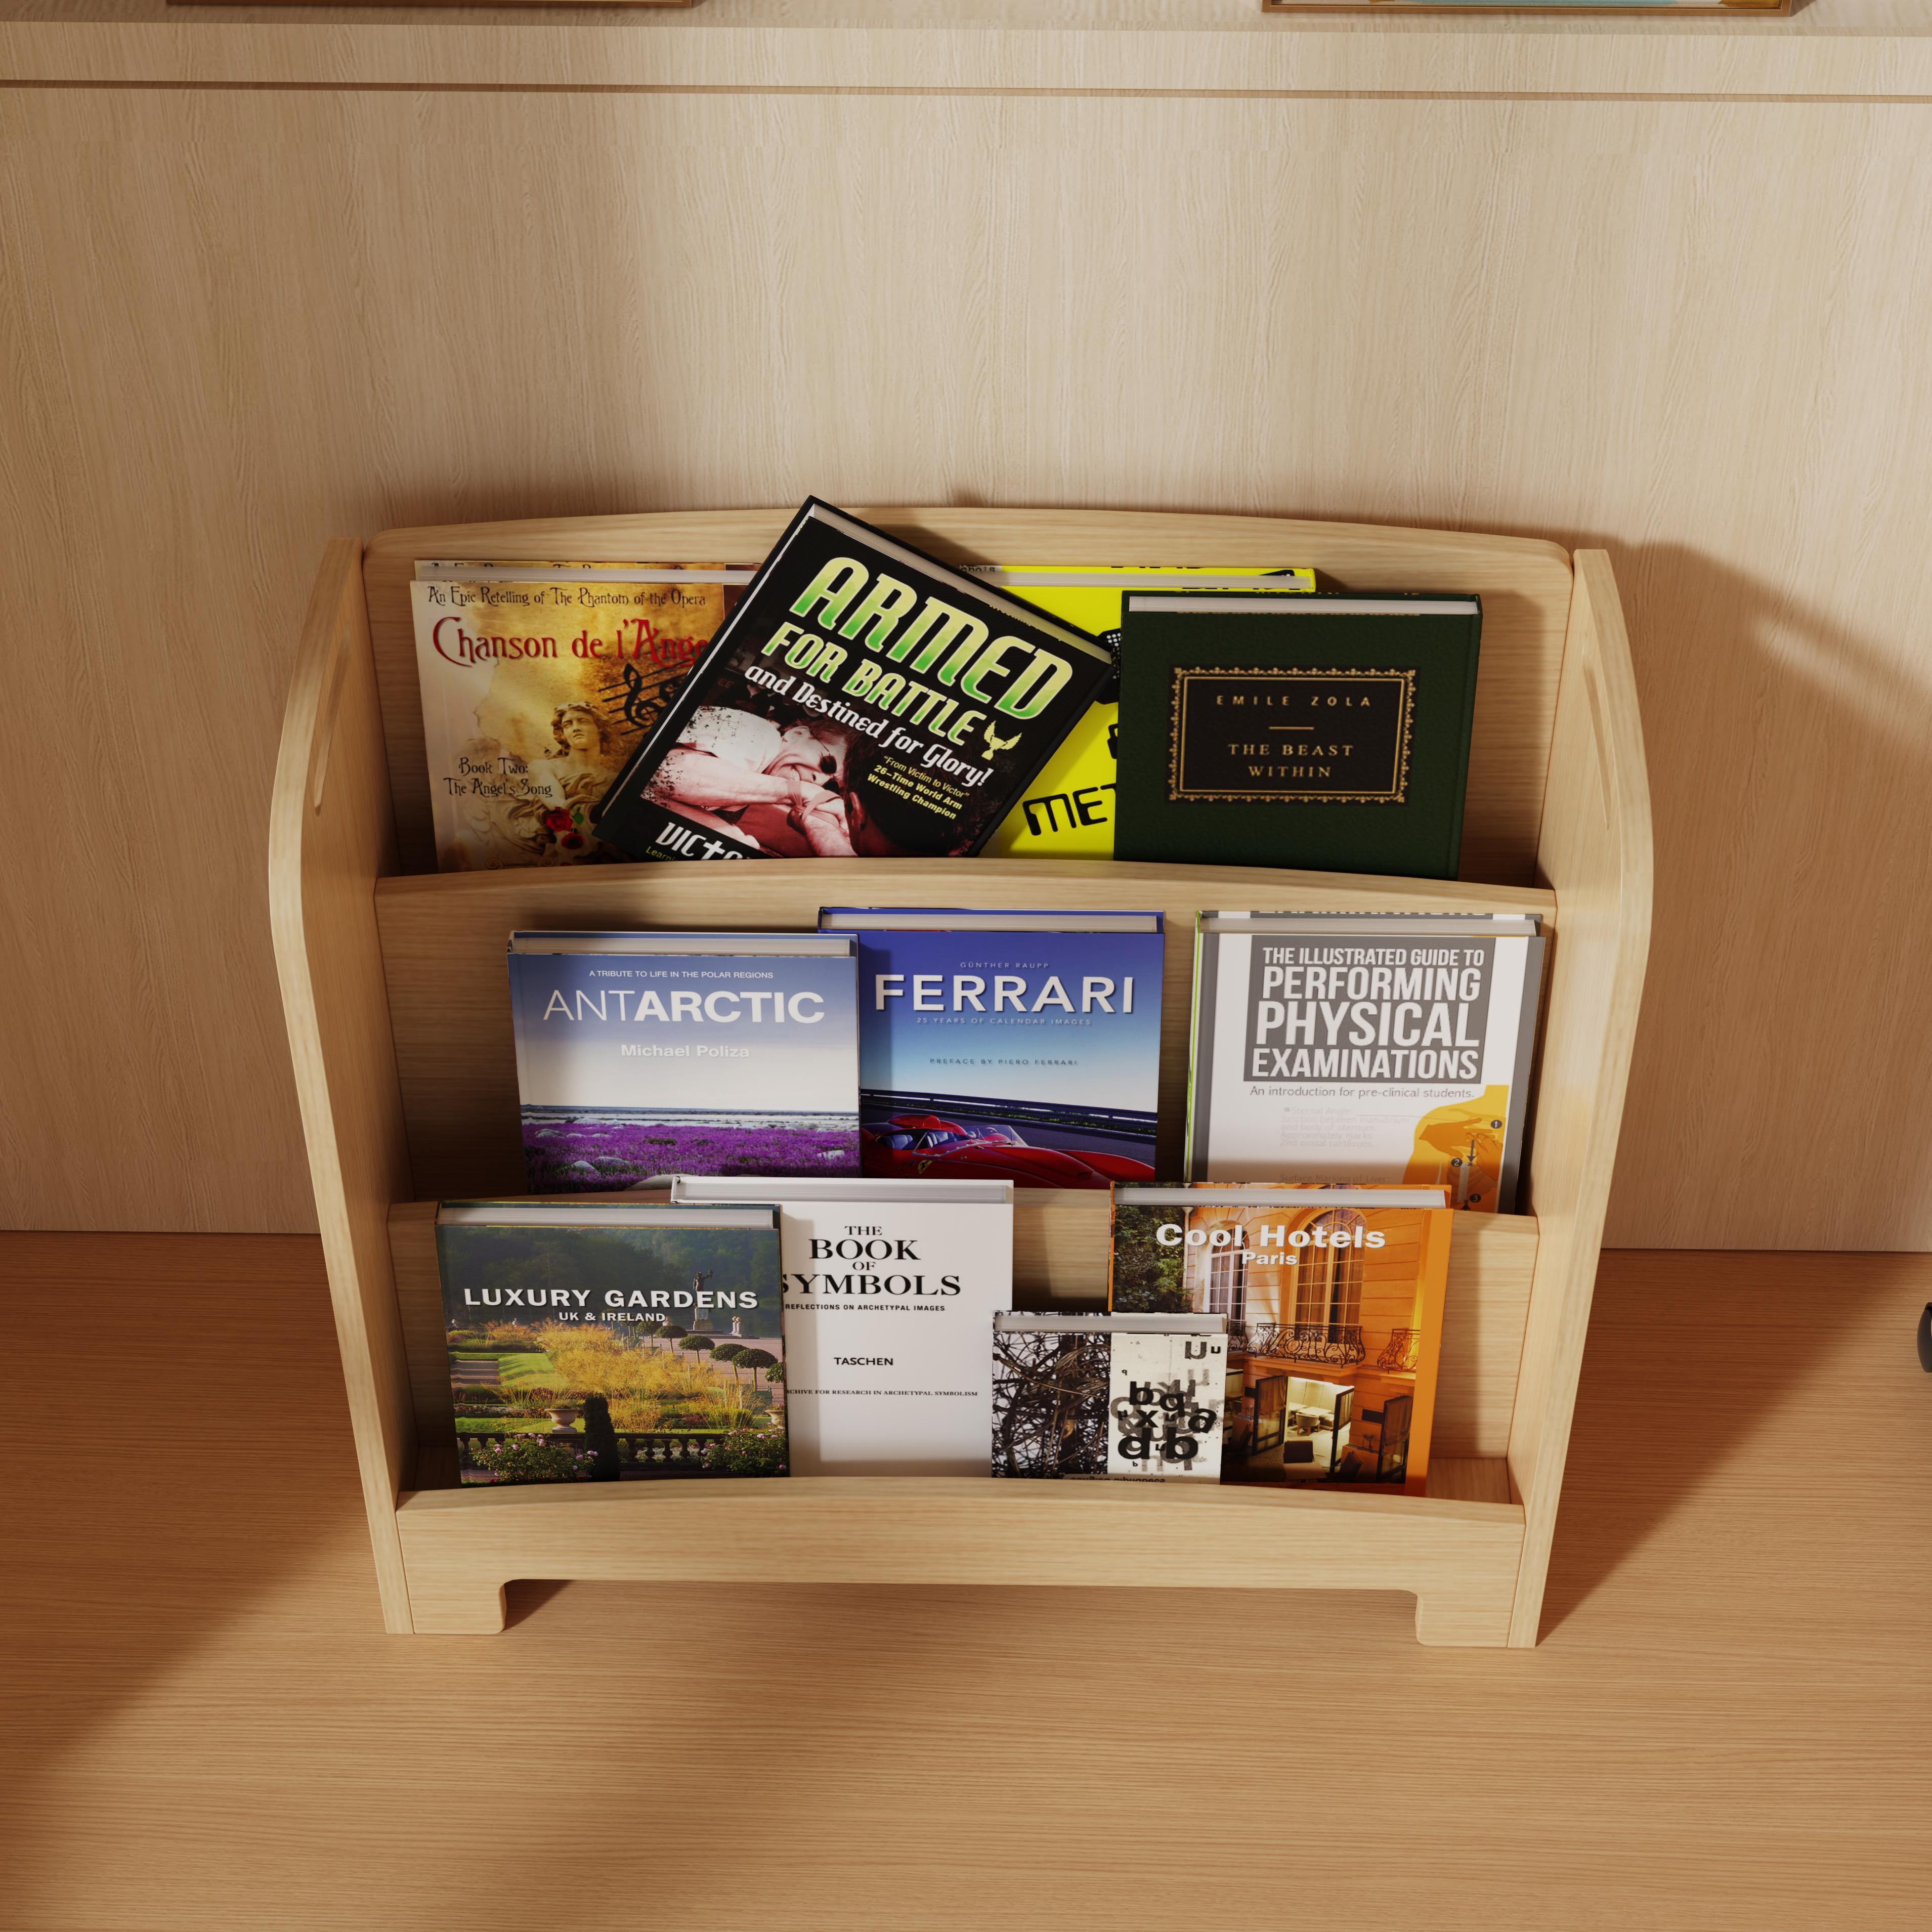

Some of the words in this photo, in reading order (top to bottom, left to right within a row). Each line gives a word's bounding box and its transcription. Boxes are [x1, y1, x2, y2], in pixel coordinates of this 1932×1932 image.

[427, 586, 446, 606] An
[451, 586, 476, 607] Epic
[480, 586, 530, 607] Retelling
[534, 591, 545, 605] of
[550, 587, 572, 606] The
[578, 587, 629, 607] Phantom
[634, 592, 645, 605] of
[650, 592, 666, 607] the
[671, 588, 706, 608] Opera
[433, 616, 557, 667] Chanson
[572, 629, 603, 658] de
[789, 557, 1073, 719] ARMED
[761, 621, 848, 684] FOR
[841, 659, 988, 746] BATTLE
[1216, 695, 1290, 706] EMILE
[1311, 696, 1370, 707] ZOLA
[744, 665, 796, 697] and
[792, 682, 887, 739] Destined
[878, 726, 924, 754] for
[920, 743, 994, 787] Glory!
[1228, 744, 1270, 756] THE
[1281, 744, 1353, 756] BEAST
[458, 757, 493, 776] Book
[497, 757, 529, 776] Two:
[908, 766, 932, 784] Victim
[932, 779, 941, 788] to
[1248, 765, 1332, 778] WITHIN
[443, 777, 467, 796] The
[471, 778, 516, 798] Angel's
[516, 778, 553, 798] Song
[867, 773, 911, 800] Wrestling
[912, 794, 957, 820] Champion
[916, 783, 943, 801] World
[942, 796, 963, 810] Arm
[1263, 947, 1295, 964] THE
[1299, 947, 1407, 965] ILLUSTRATED
[1410, 949, 1460, 966] GUIDE
[1463, 949, 1485, 966] TO
[875, 974, 1134, 1013] FERRARI
[1262, 966, 1481, 1002] PERFORMING
[543, 990, 825, 1023] ANTARCTIC
[1256, 1000, 1480, 1047] PHYSICAL
[620, 1044, 690, 1058] Michael
[697, 1045, 750, 1058] Poliza
[1252, 1047, 1479, 1080] EXAMINATIONS
[1250, 1086, 1265, 1096] An
[1268, 1086, 1336, 1097] introduction
[1339, 1086, 1355, 1097] for
[1358, 1087, 1419, 1099] pre-clinical
[1423, 1087, 1475, 1098] students.
[1280, 1174, 1313, 1182] Surface
[845, 1225, 882, 1236] THE
[1155, 1223, 1243, 1247] Cool
[1260, 1224, 1387, 1249] Hotels
[808, 1238, 921, 1260] BOOK
[1242, 1251, 1298, 1265] Paris
[852, 1261, 876, 1271] OF
[463, 1288, 591, 1306] LUXURY
[605, 1290, 758, 1309] GARDENS
[559, 1312, 579, 1321] UK
[584, 1312, 597, 1321] &
[602, 1312, 666, 1322] IRELAND
[834, 1357, 893, 1366] TASCHEN
